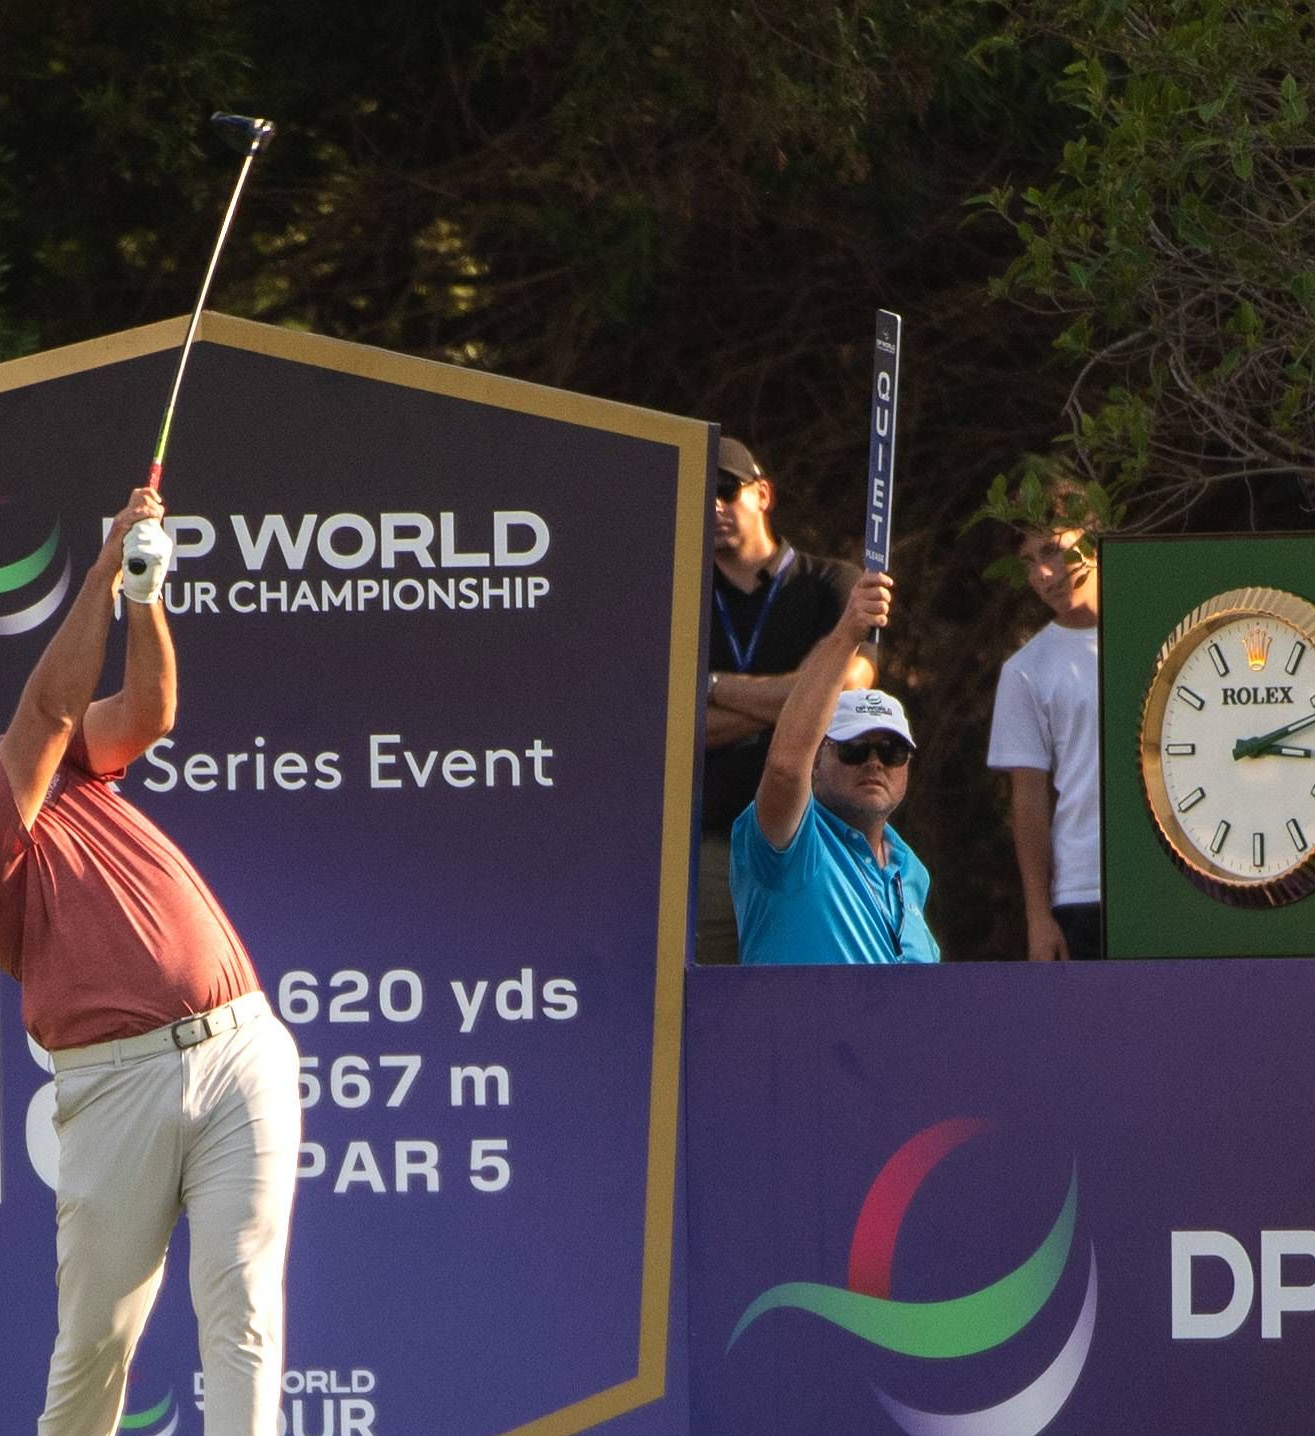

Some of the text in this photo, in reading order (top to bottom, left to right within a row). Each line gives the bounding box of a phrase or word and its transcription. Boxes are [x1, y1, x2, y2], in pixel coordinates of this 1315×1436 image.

[871, 371, 891, 543] QUIET
[102, 511, 550, 572] P WORLD
[865, 549, 885, 564] PLEASE
[227, 576, 550, 613] CHAMPIONSHIP
[1222, 687, 1294, 705] ROLEX
[143, 733, 554, 792] Series Event
[278, 968, 578, 1032] 620 yds
[298, 1055, 510, 1109] 567 m
[469, 1139, 511, 1192] 5
[282, 1369, 375, 1394] ORLD
